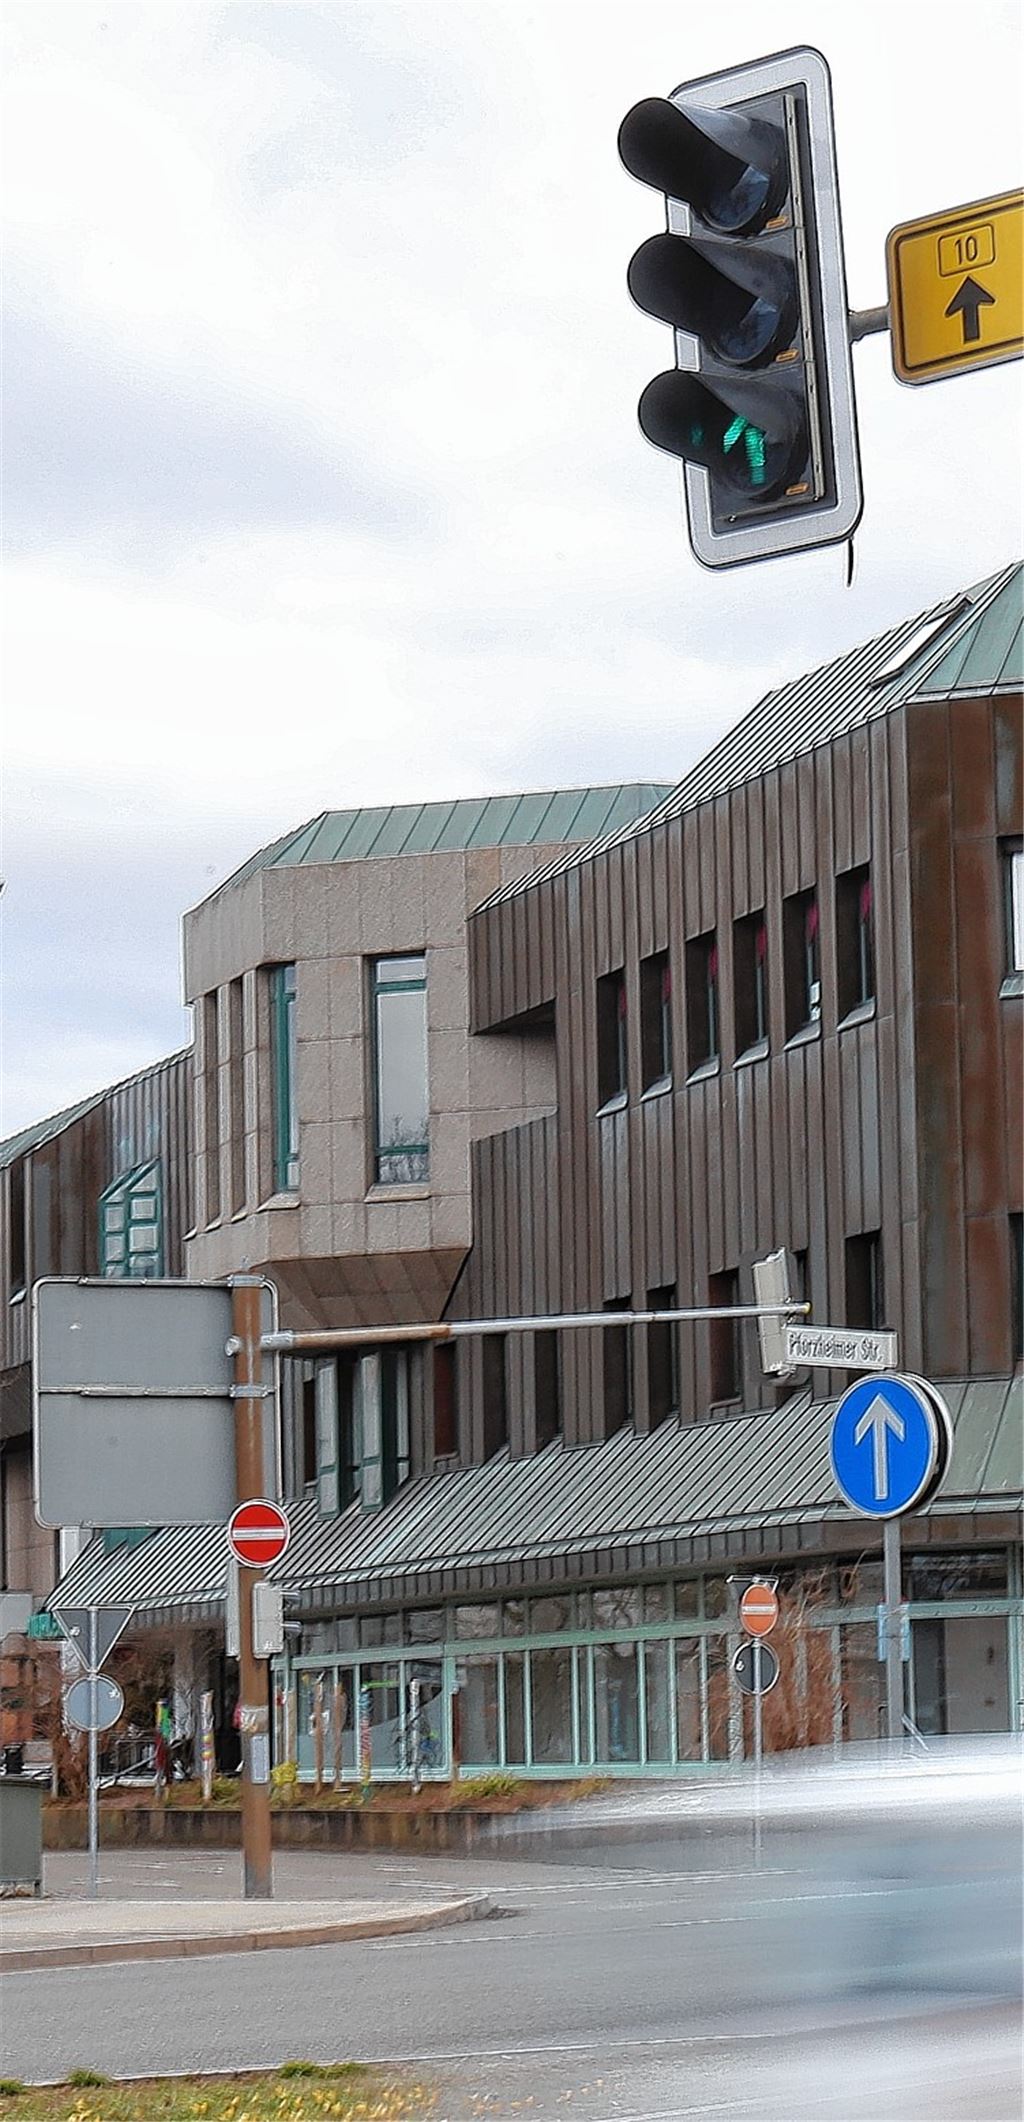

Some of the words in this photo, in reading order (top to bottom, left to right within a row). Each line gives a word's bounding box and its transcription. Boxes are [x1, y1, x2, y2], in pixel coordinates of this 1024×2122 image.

[954, 235, 978, 265] 10
[789, 1332, 858, 1360] Pforzheimer
[860, 1336, 883, 1362] Str.
